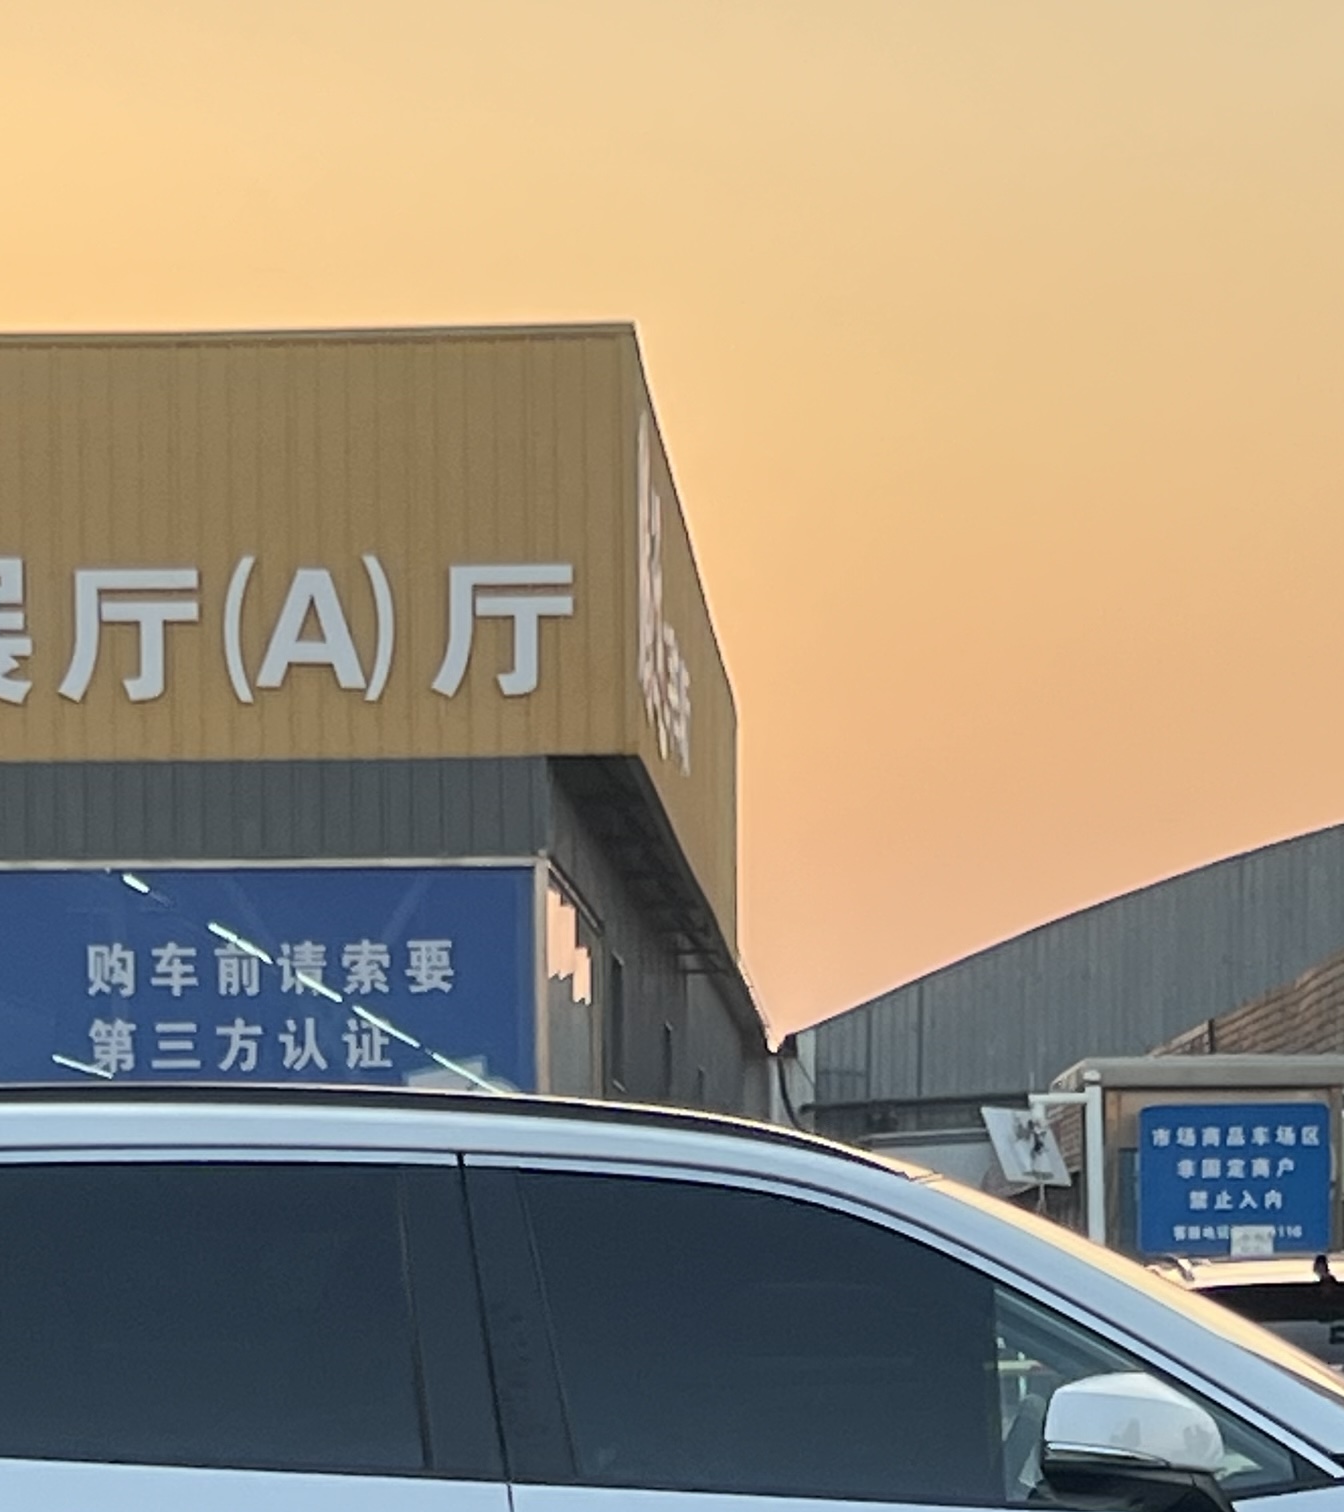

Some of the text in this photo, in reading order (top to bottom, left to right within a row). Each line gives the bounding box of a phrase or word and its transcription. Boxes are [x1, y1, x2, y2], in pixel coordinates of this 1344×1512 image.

[86, 940, 454, 997] 购车前请索要
[88, 1017, 393, 1072] 第三方认证
[1189, 1189, 1284, 1210] 禁止入内
